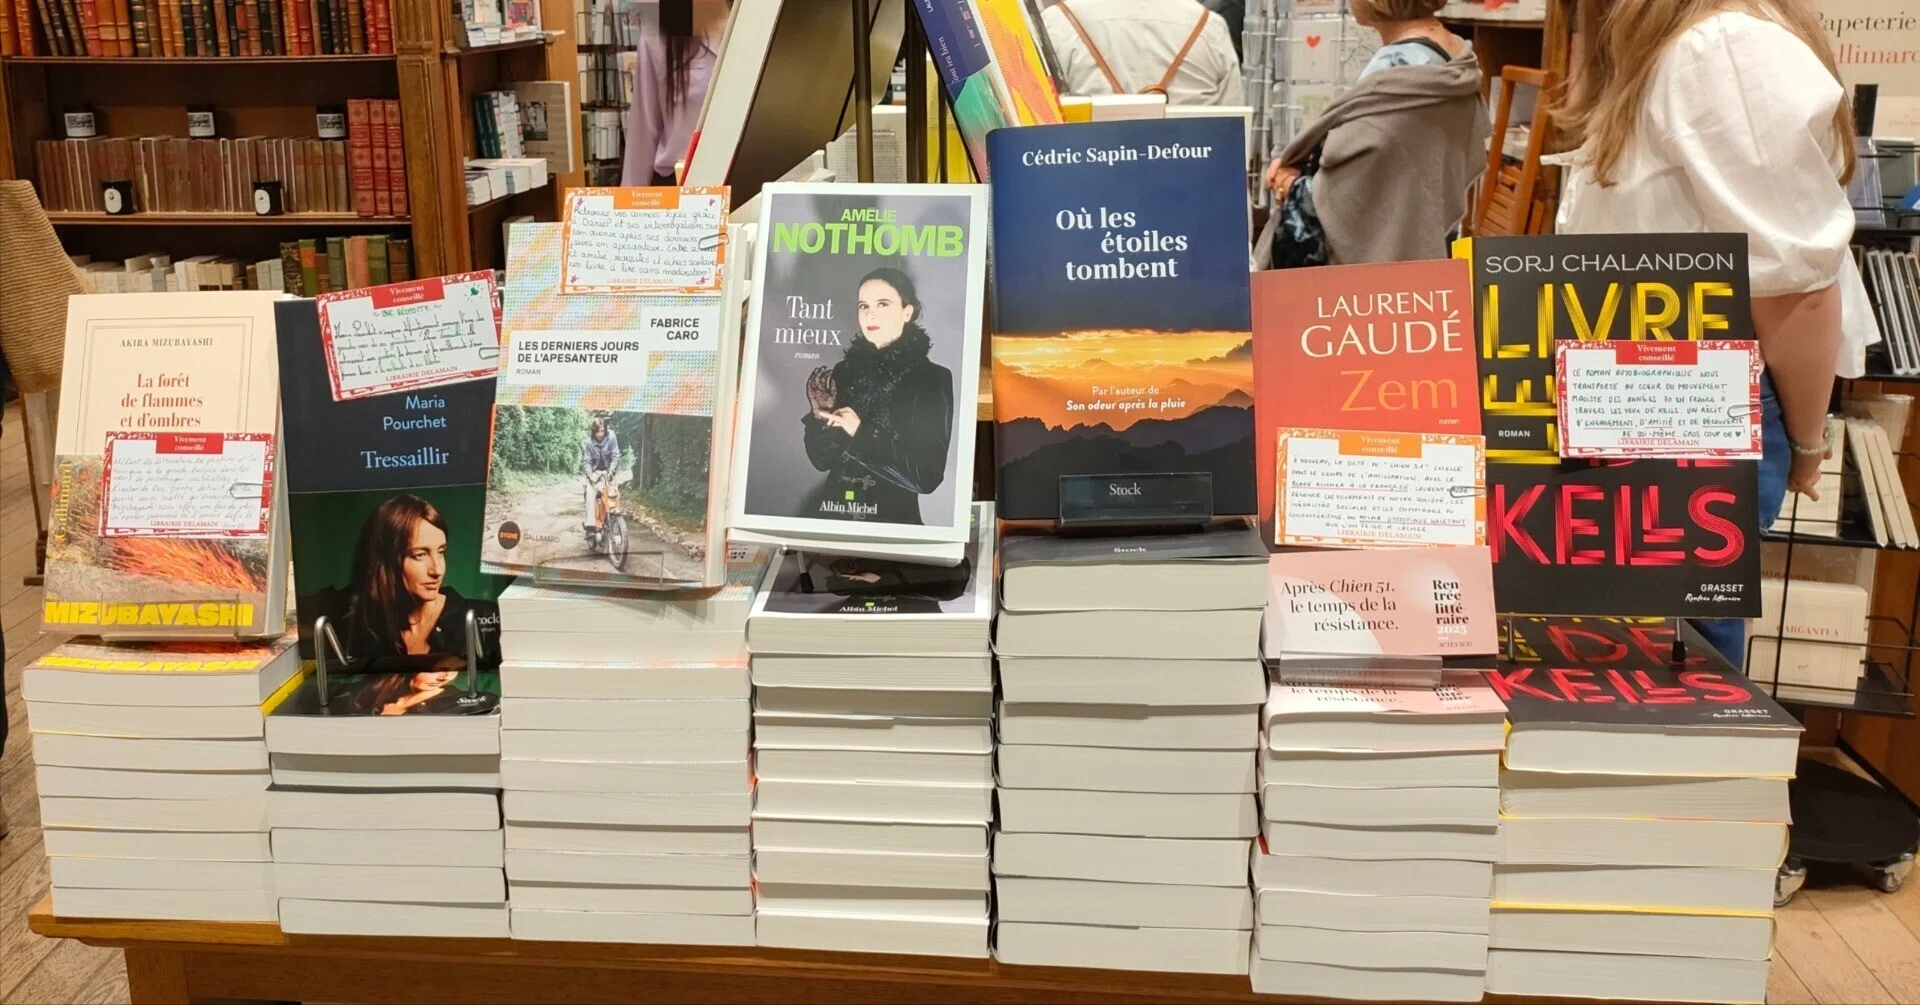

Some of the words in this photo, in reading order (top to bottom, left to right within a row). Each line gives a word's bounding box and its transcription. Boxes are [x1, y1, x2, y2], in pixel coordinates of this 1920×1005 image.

[1834, 44, 1920, 64] llimar
[1022, 147, 1082, 166] Cédric
[1086, 143, 1212, 166] Sapin-Defour
[1056, 206, 1094, 230] Où
[1100, 207, 1136, 229] les
[773, 222, 964, 258] NOTHOMB
[1101, 230, 1188, 254] étoiles
[1066, 257, 1179, 281] tombent
[1485, 255, 1554, 273] SORJ
[1562, 252, 1734, 272] CHALANDON
[389, 285, 424, 296] Vivement
[786, 295, 834, 320] Tant
[1317, 289, 1453, 318] LAURENT
[650, 318, 700, 328] FABRICE
[1482, 282, 1734, 359] LIVRE
[666, 331, 699, 341] CARO
[773, 322, 842, 346] mieux
[1300, 309, 1463, 358] GAUDÉ
[120, 339, 149, 348] AKIRA
[152, 338, 213, 347] MIZUBAYASHI
[518, 341, 539, 351] LES
[541, 341, 598, 351] DERNIERS
[600, 342, 640, 351] JOURS
[1636, 344, 1676, 353] Vivement
[517, 353, 533, 363] DE
[534, 353, 618, 363] L'APESANTEUR
[794, 352, 820, 360] roman
[1638, 353, 1675, 361] conseillé
[385, 371, 420, 382] LIBRAIRIE
[420, 366, 459, 378] DELAMAIN
[516, 368, 542, 376] ROMAN
[137, 373, 153, 388] La
[158, 373, 190, 388] forêt
[1092, 386, 1108, 396] Par
[1110, 385, 1145, 396] l'auteur
[1148, 385, 1160, 395] de
[1340, 369, 1458, 413] Zem
[121, 393, 138, 408] de
[141, 393, 203, 408] flammes
[406, 395, 446, 410] Maria
[1066, 400, 1086, 411] Son
[1088, 398, 1116, 410] odeur
[1118, 398, 1146, 413] après
[1148, 398, 1158, 409] la
[1160, 398, 1186, 412] pluie
[120, 413, 133, 427] et
[137, 412, 201, 427] d'ombres
[383, 415, 447, 431] Pourchet
[174, 435, 207, 443] Vivement
[1361, 435, 1400, 445] Vivement
[1498, 430, 1531, 438] ROMAN
[1361, 445, 1398, 454] conseillé
[361, 447, 450, 470] Tressaillir
[1109, 482, 1142, 496] Stock
[54, 461, 73, 541] Gallimard
[819, 500, 846, 513] Albin
[846, 501, 878, 515] Michel
[1486, 484, 1745, 567] KELLS
[523, 533, 560, 543] GALLIMARD
[1337, 529, 1376, 537] LIBRAIRIE
[1378, 531, 1422, 539] DELAMAIN
[1281, 580, 1326, 598] Après
[1329, 579, 1373, 593] Chien
[1376, 581, 1396, 593] 51,
[1433, 589, 1462, 601] trée
[1700, 583, 1744, 593] GRASSET
[44, 601, 254, 627] MIZUBAYASHI
[838, 605, 866, 613] Albin
[866, 605, 898, 613] Michel
[1290, 599, 1304, 613] le
[1307, 598, 1356, 617] temps
[1359, 597, 1379, 612] de
[1383, 597, 1397, 611] la
[478, 612, 500, 625] tock
[1314, 617, 1399, 632] résistance.
[1436, 614, 1469, 625] raire
[1436, 625, 1468, 636] 2025
[36, 655, 263, 672] MIZUBAYASHI
[1480, 668, 1752, 704] KELLS
